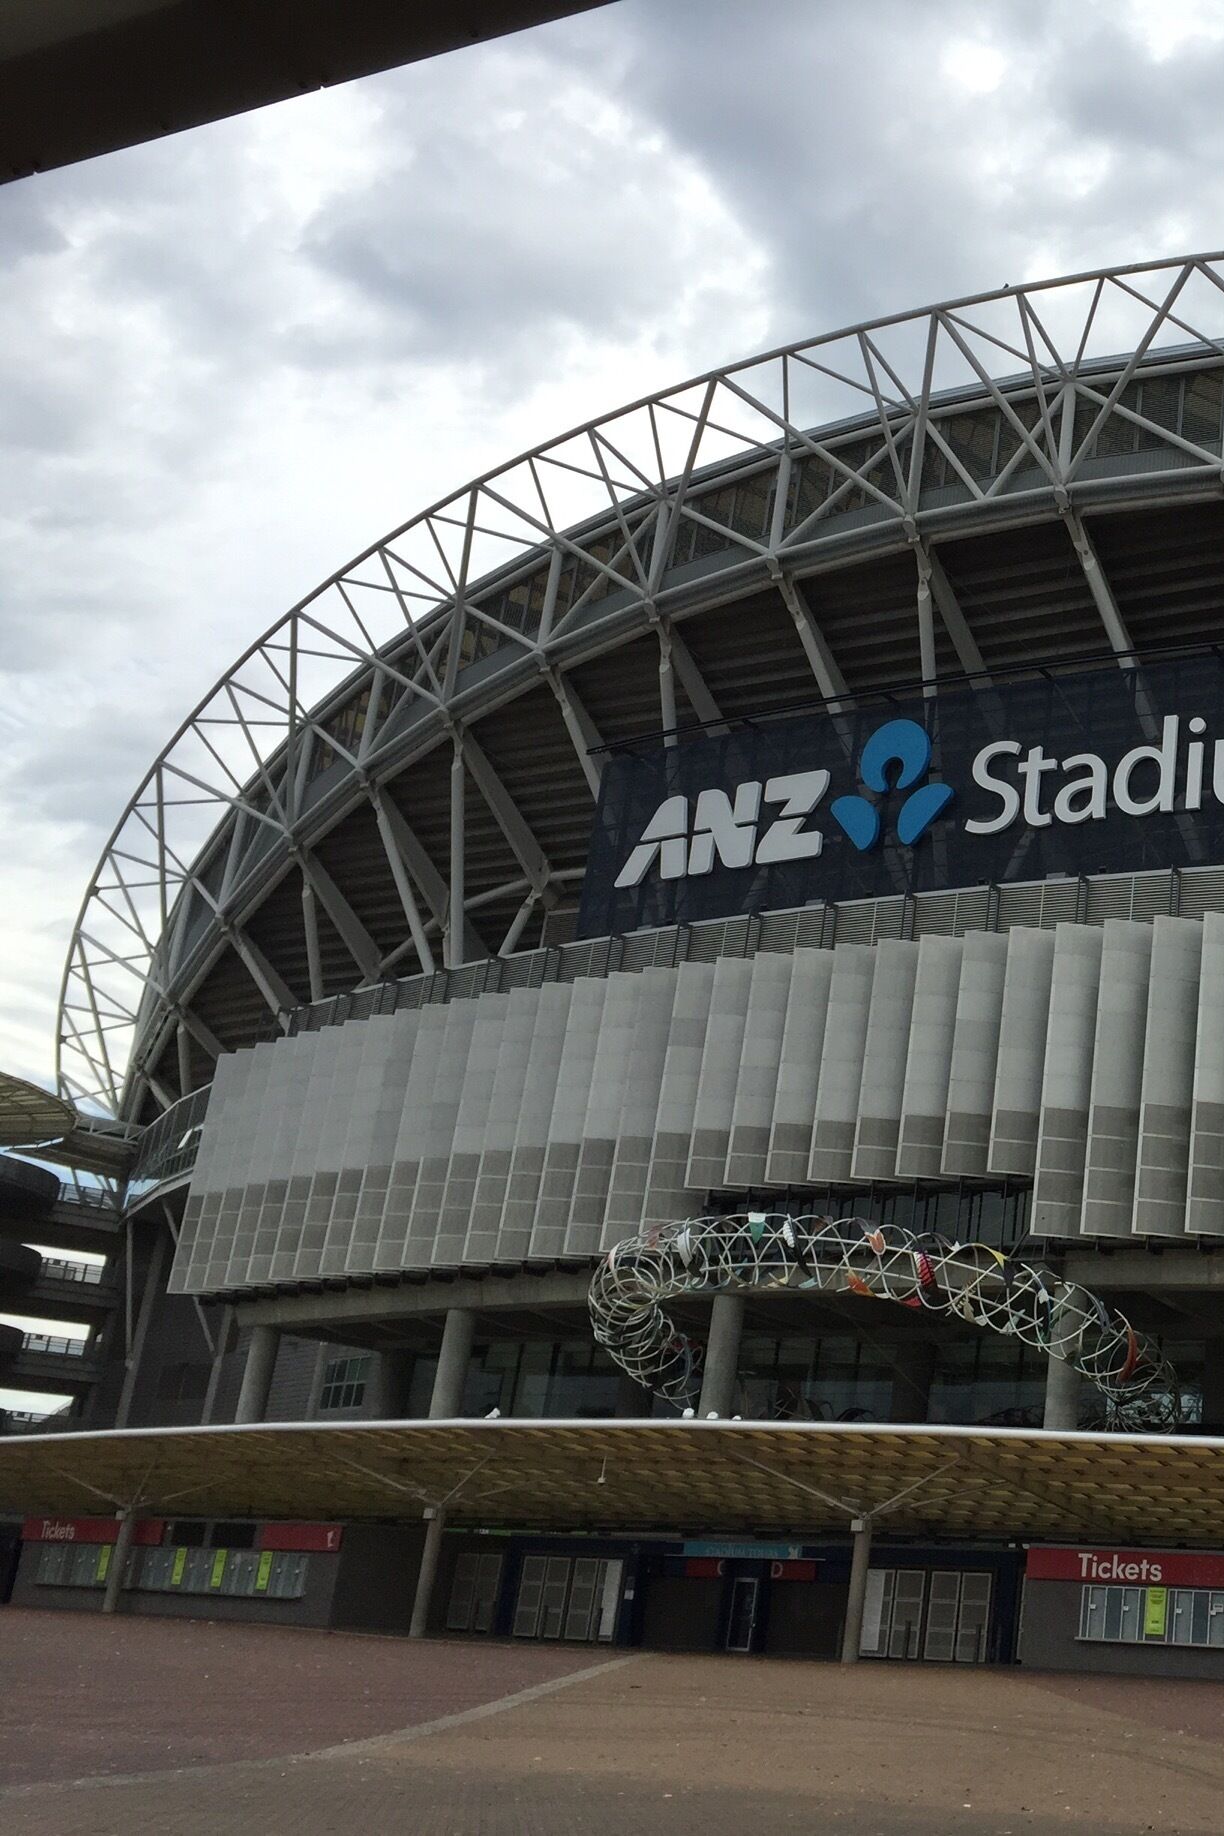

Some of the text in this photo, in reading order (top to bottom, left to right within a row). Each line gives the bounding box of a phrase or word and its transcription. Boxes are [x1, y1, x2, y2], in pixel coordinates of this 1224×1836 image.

[614, 768, 830, 889] ANZ
[41, 1520, 75, 1540] Tickets
[770, 1561, 784, 1578] D
[1078, 1553, 1162, 1582] Tickets
